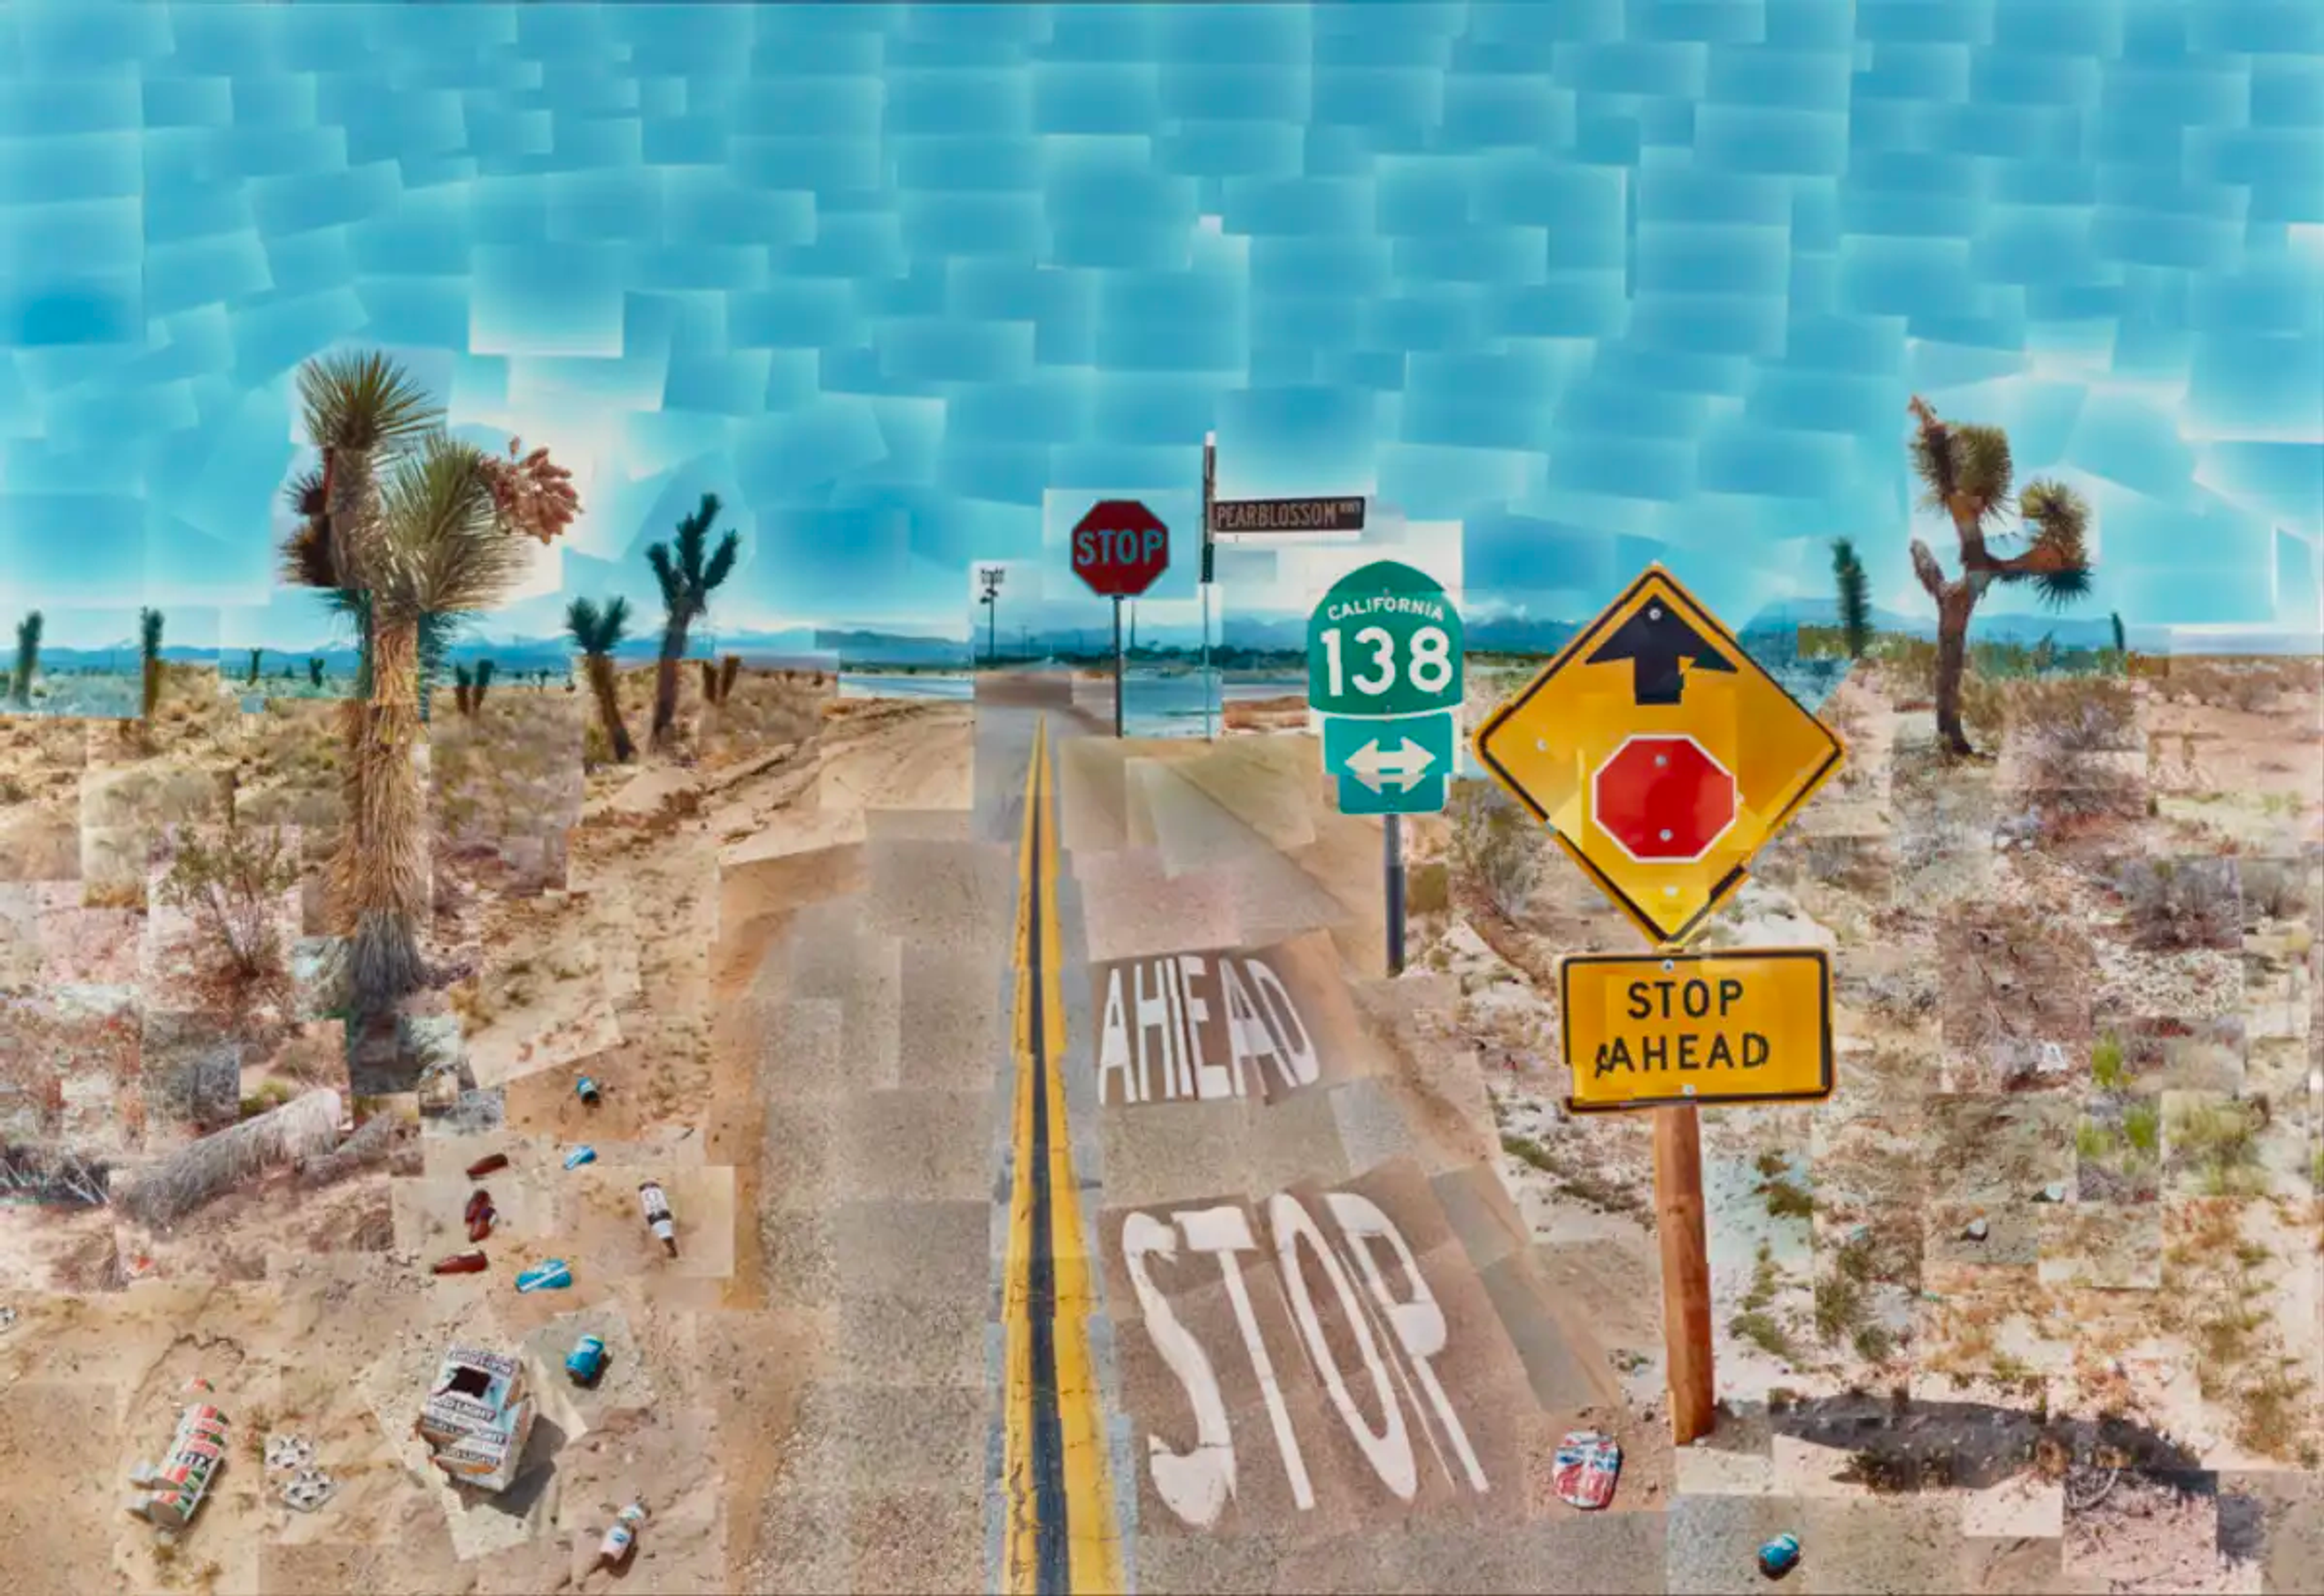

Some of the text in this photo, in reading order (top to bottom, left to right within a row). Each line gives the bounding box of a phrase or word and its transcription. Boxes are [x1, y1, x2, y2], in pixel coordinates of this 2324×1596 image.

[1217, 502, 1337, 528] PEARBLOSSOM
[1077, 528, 1164, 566] STOP
[1328, 597, 1444, 620] CALIFORNIA
[1320, 626, 1452, 696] 138
[1627, 979, 1743, 1019] STOP
[1594, 1032, 1770, 1079] AHEAD
[1122, 1193, 1490, 1528] STOP
